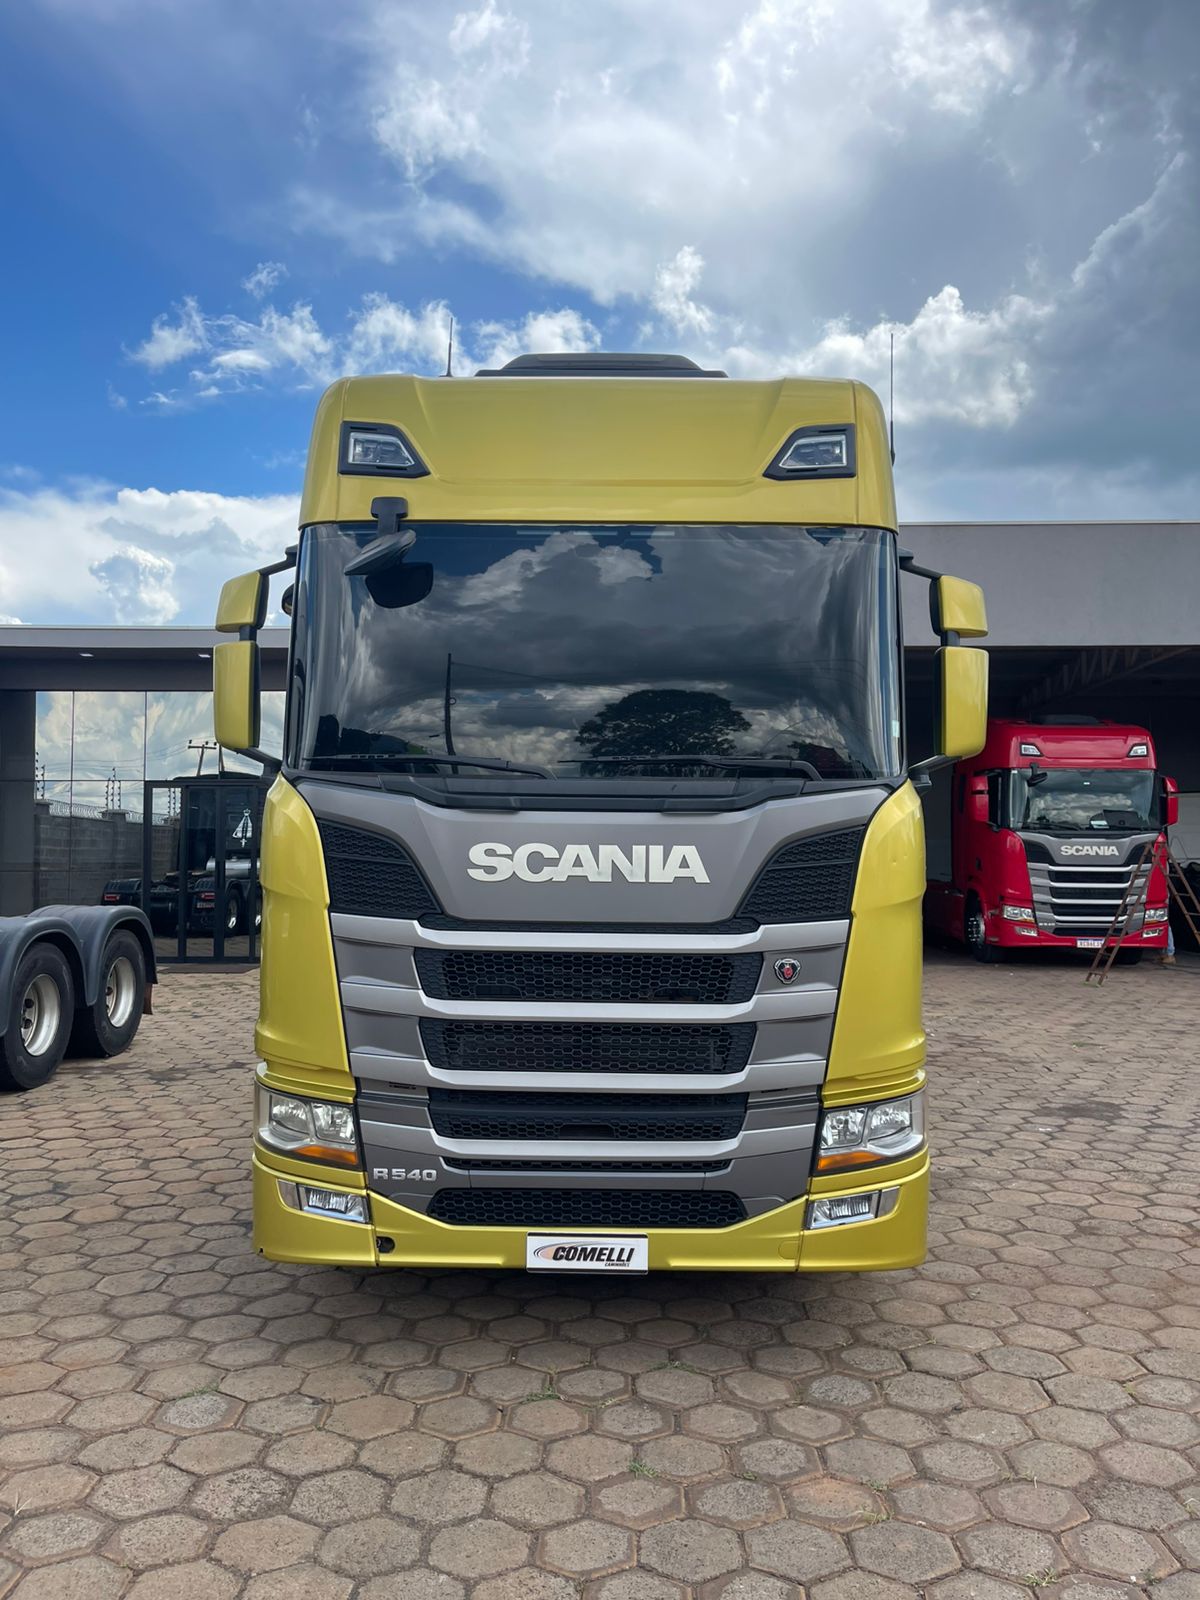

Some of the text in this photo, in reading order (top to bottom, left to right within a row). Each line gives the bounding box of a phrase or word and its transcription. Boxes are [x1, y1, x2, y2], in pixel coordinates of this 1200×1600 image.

[1060, 845, 1119, 856] SCANIA
[467, 842, 711, 883] SCANIA
[552, 1246, 635, 1262] COMELLI
